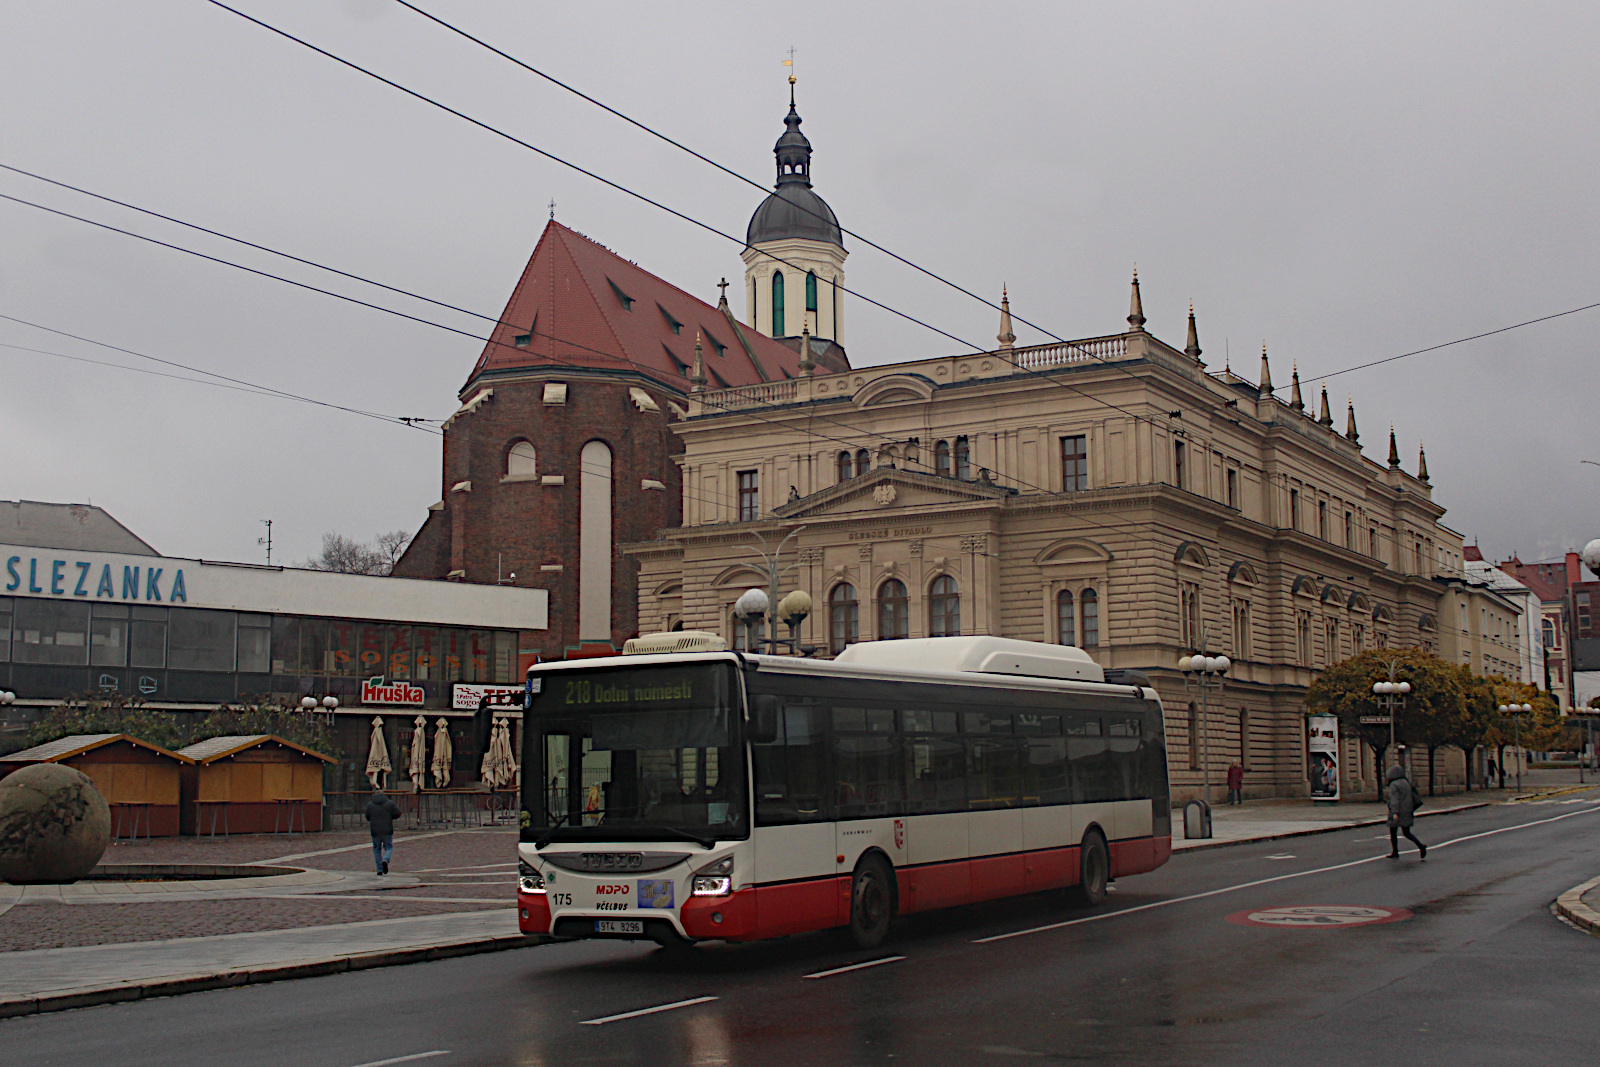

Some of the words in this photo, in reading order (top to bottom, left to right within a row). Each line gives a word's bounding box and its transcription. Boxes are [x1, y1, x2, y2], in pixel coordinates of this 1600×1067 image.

[6, 556, 188, 601] SLEZANKA
[334, 624, 487, 656] TEXTIL
[334, 650, 487, 673] sogoss
[363, 681, 423, 703] Hruška
[565, 680, 591, 704] 218
[581, 853, 642, 868] IVECO
[596, 885, 630, 895] MDPO
[552, 893, 573, 906] 175
[596, 900, 629, 911] VČELBUS
[600, 921, 615, 932] 9T4
[620, 922, 640, 932] 8296
